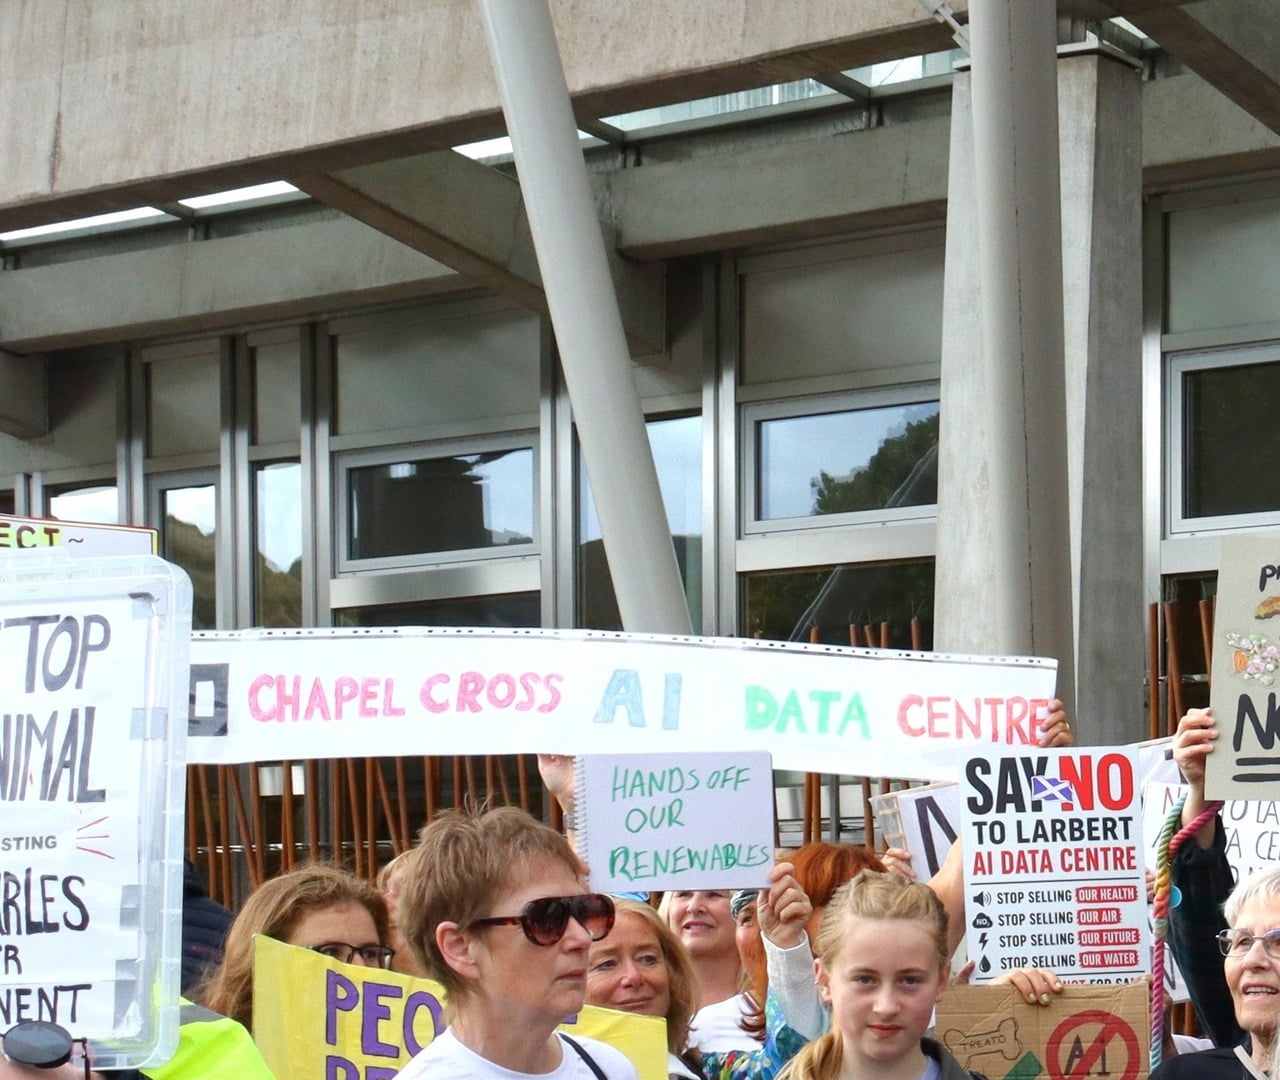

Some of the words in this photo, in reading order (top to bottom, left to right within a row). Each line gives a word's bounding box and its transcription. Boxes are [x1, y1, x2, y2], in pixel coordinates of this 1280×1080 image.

[248, 673, 405, 723] CHAPEL
[420, 672, 563, 714] CROSS
[594, 669, 682, 730] AI
[745, 684, 872, 740] DATA
[897, 694, 1049, 746] CENTRE
[611, 765, 699, 802] HANDS
[706, 765, 752, 791] OFF
[965, 756, 1048, 815] SAY
[1058, 753, 1134, 811] NO
[625, 799, 685, 834] OUR
[972, 821, 1006, 845] TO
[1016, 816, 1133, 844] LARBERT
[610, 843, 770, 882] RENEWABLES
[972, 851, 993, 875] AI
[1001, 849, 1054, 875] DATA
[1060, 846, 1137, 873] CENTRE
[996, 892, 1024, 905] STOP
[1028, 889, 1072, 904] SELLING
[1078, 889, 1098, 901] OUR
[1099, 887, 1134, 900] HEALTH
[998, 914, 1026, 927] STOP
[1030, 911, 1074, 925] SELLING
[1079, 910, 1099, 924] OUR
[1101, 909, 1118, 922] AIR
[999, 935, 1027, 948] STOP
[1030, 932, 1075, 947] SELLING
[1080, 931, 1100, 945] OUR
[1102, 930, 1137, 944] FUTURE
[1000, 957, 1028, 970] STOP
[1032, 954, 1076, 968] SELLING
[1081, 953, 1101, 966] OUR
[1103, 952, 1136, 965] WATER
[1063, 1034, 1111, 1077] AI
